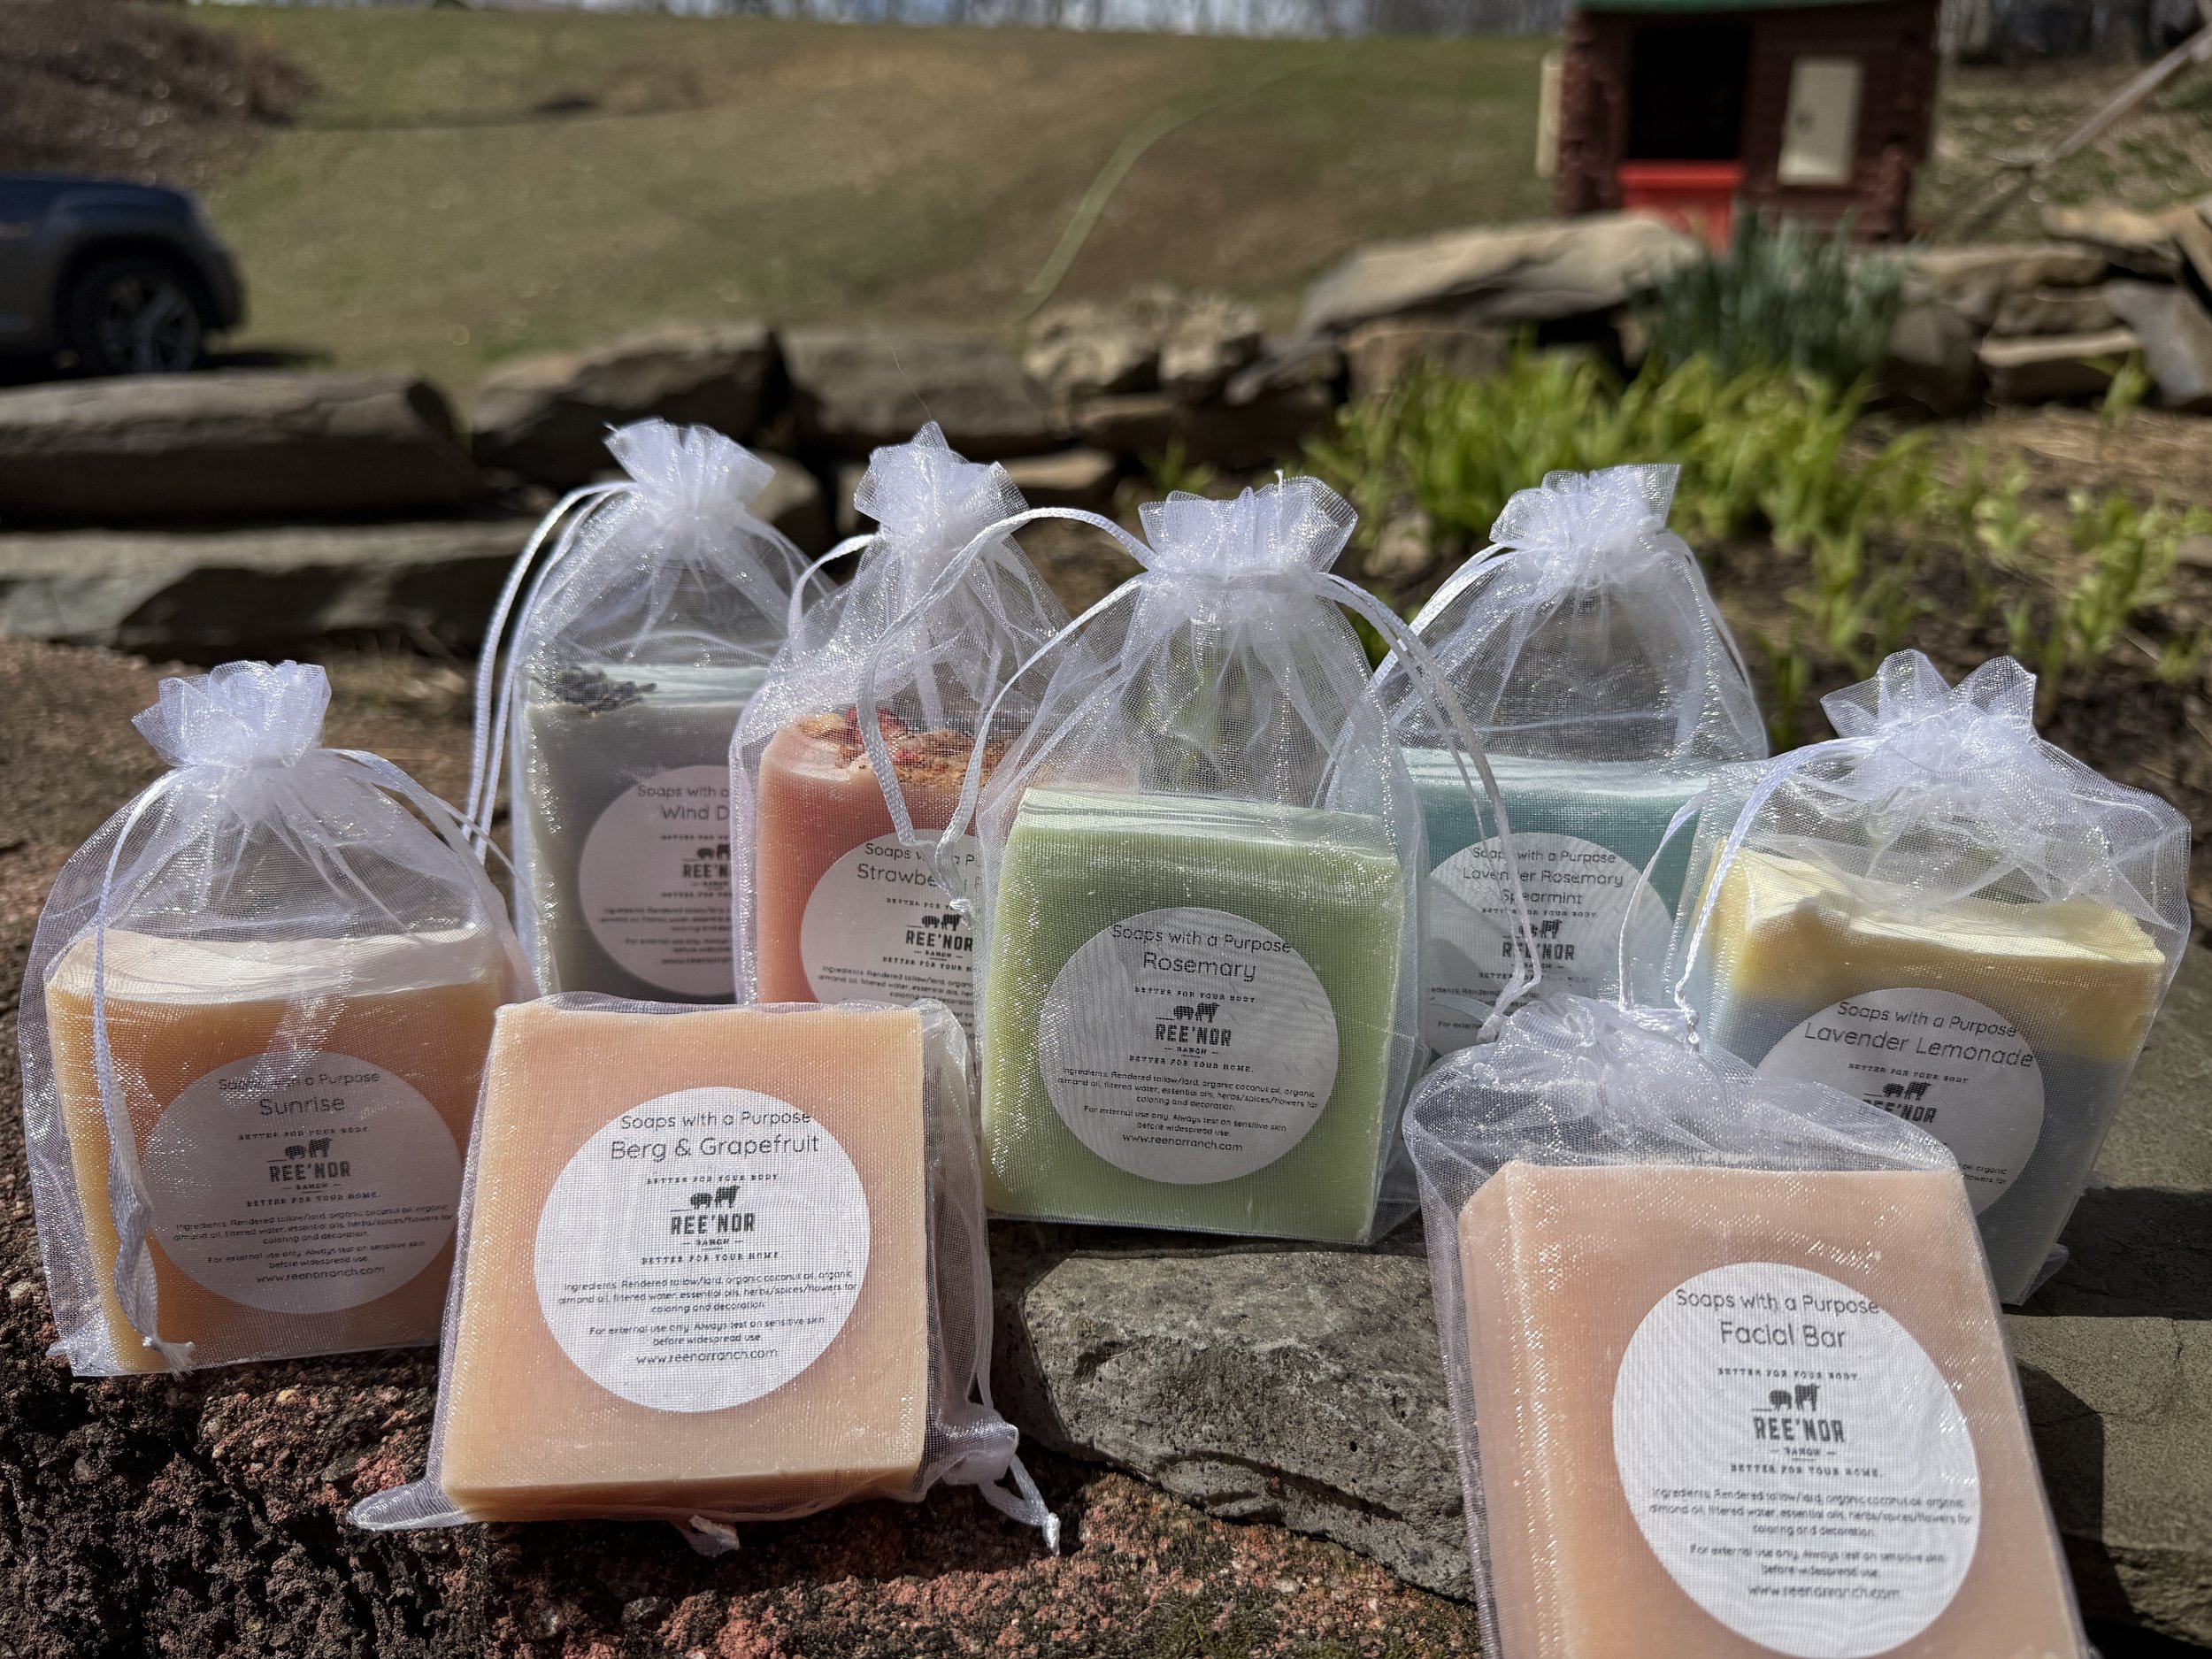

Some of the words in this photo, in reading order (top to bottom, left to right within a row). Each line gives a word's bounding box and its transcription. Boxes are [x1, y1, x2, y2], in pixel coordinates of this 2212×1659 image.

[637, 785, 681, 800] Soaps
[687, 786, 716, 797] with
[721, 788, 729, 798] a
[661, 805, 710, 819] Wind
[865, 843, 910, 860] Soaps
[1473, 848, 1505, 859] Soap
[1517, 850, 1542, 860] with
[1548, 852, 1555, 861] a
[1561, 850, 1616, 864] Purpose
[683, 864, 728, 878] REE'N
[1463, 867, 1535, 882] Lavener
[1541, 871, 1623, 887] Rosemary
[906, 930, 972, 951] REE'NOR
[1112, 925, 1163, 944] Soaps
[1169, 931, 1202, 945] with
[1207, 935, 1217, 947] a
[1225, 934, 1291, 953] Purpose
[883, 956, 915, 965] BETTER
[1143, 951, 1256, 982] Rosemary
[1135, 987, 1171, 995] BETTER
[1837, 1002, 1889, 1022] Soaps
[1895, 1011, 1928, 1026] with
[1933, 1016, 1944, 1028] a
[1950, 1015, 2017, 1038] Purpose
[1156, 1024, 1232, 1046] REE'NOR
[1177, 1046, 1207, 1055] RANCH
[1804, 1023, 1909, 1052] Lavender
[1916, 1037, 2033, 1068] Lemonade
[1129, 1055, 1165, 1064] BETTER
[319, 1072, 380, 1086] Purpose
[1111, 1071, 1150, 1081] Rendered
[1848, 1064, 1886, 1072] BETTER
[1890, 1068, 1909, 1077] FOR
[259, 1097, 344, 1116] Sunrise
[621, 1115, 676, 1131] Soaps
[682, 1112, 717, 1127] with
[723, 1115, 733, 1125] a
[741, 1111, 810, 1125] Purpose
[1172, 1114, 1201, 1124] Always
[1233, 1120, 1268, 1130] sensitive
[1166, 1125, 1212, 1135] widespread
[611, 1141, 666, 1163] Berg
[675, 1139, 691, 1157] &
[701, 1133, 819, 1158] Grapefruit
[269, 1160, 350, 1182] REE'NOR
[672, 1213, 756, 1235] REE'NOR
[641, 1256, 683, 1265] BETTER
[1676, 1289, 1735, 1310] Soaps
[1740, 1294, 1778, 1311] with
[1785, 1297, 1796, 1311] a
[1803, 1294, 1879, 1317] Purpose
[1720, 1322, 1794, 1346] Facial
[1802, 1325, 1846, 1348] Bar
[1754, 1416, 1845, 1442] REE'NOR
[1731, 1463, 1776, 1473] BETTER
[1781, 1465, 1802, 1474] FOR
[1809, 1466, 1839, 1476] YOUR
